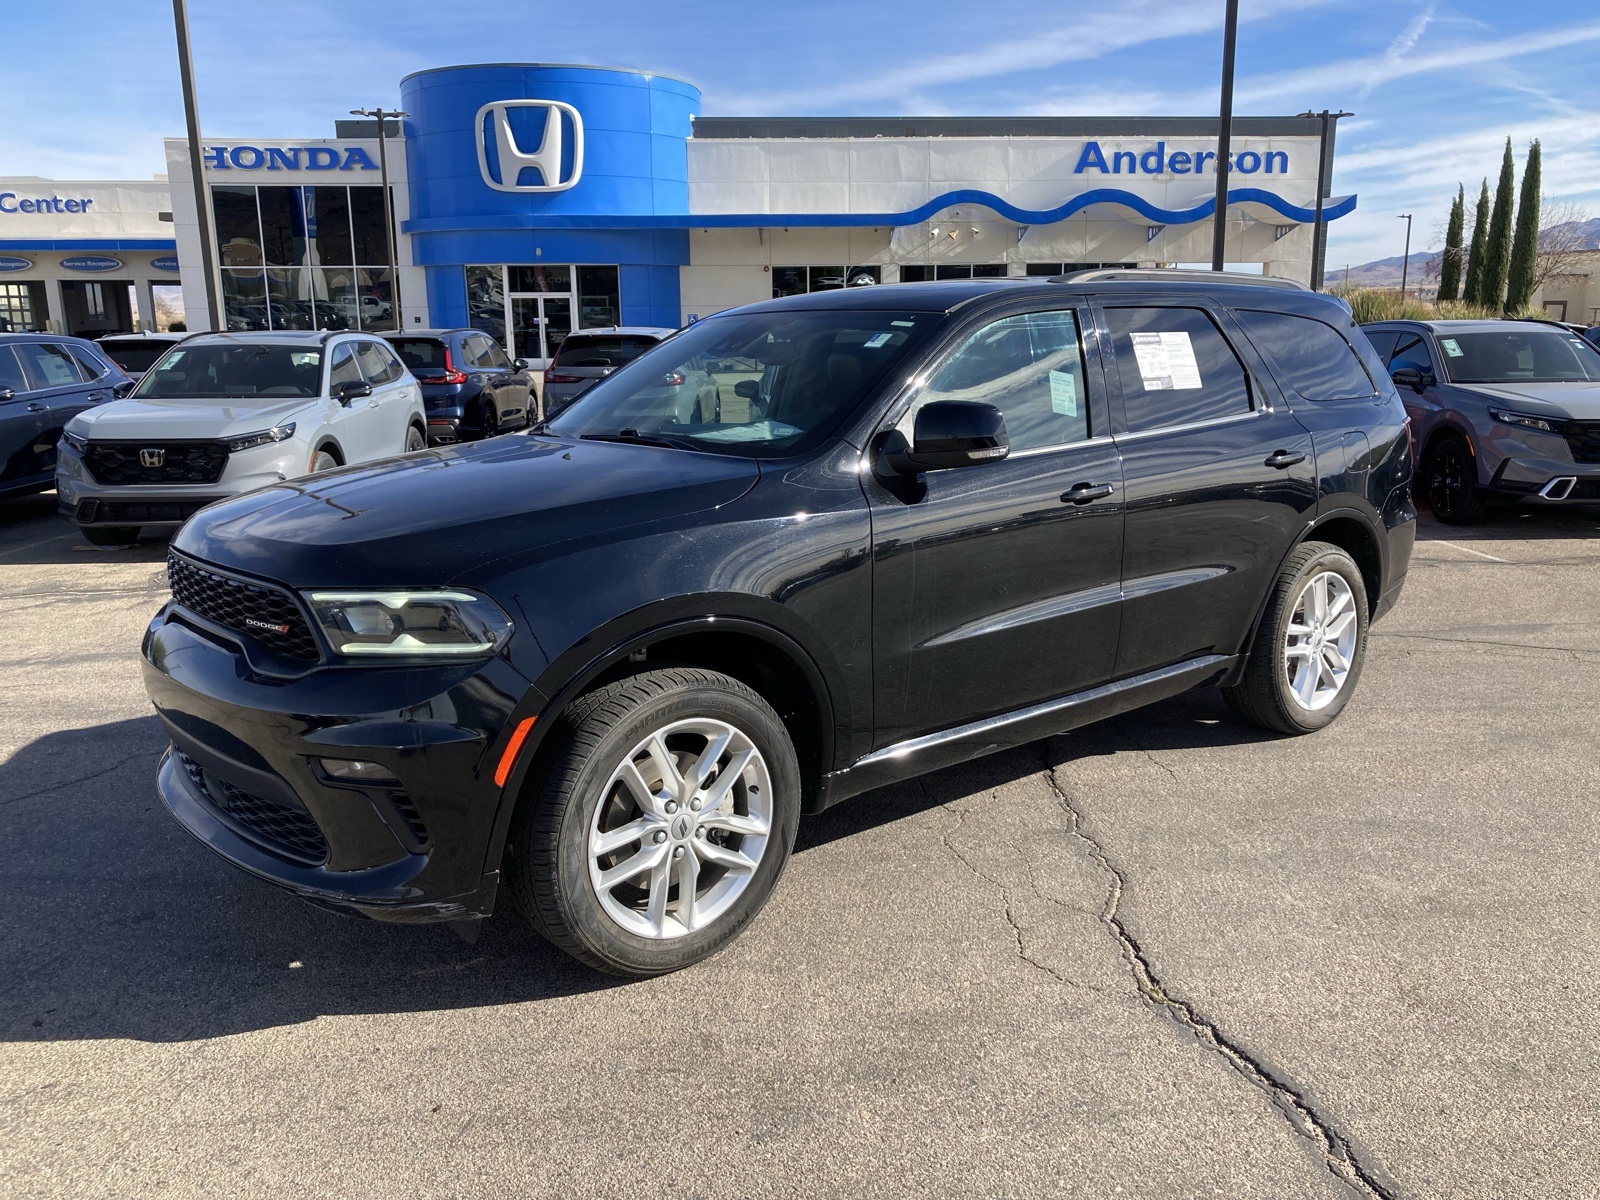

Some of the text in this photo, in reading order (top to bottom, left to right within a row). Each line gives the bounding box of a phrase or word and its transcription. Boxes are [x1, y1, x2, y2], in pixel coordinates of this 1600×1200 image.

[203, 146, 380, 170] HONDA
[0, 192, 93, 213] Center
[0, 260, 28, 268] eception
[87, 260, 118, 268] Reception
[246, 618, 284, 632] DODGE
[623, 696, 700, 742] PHANTOM
